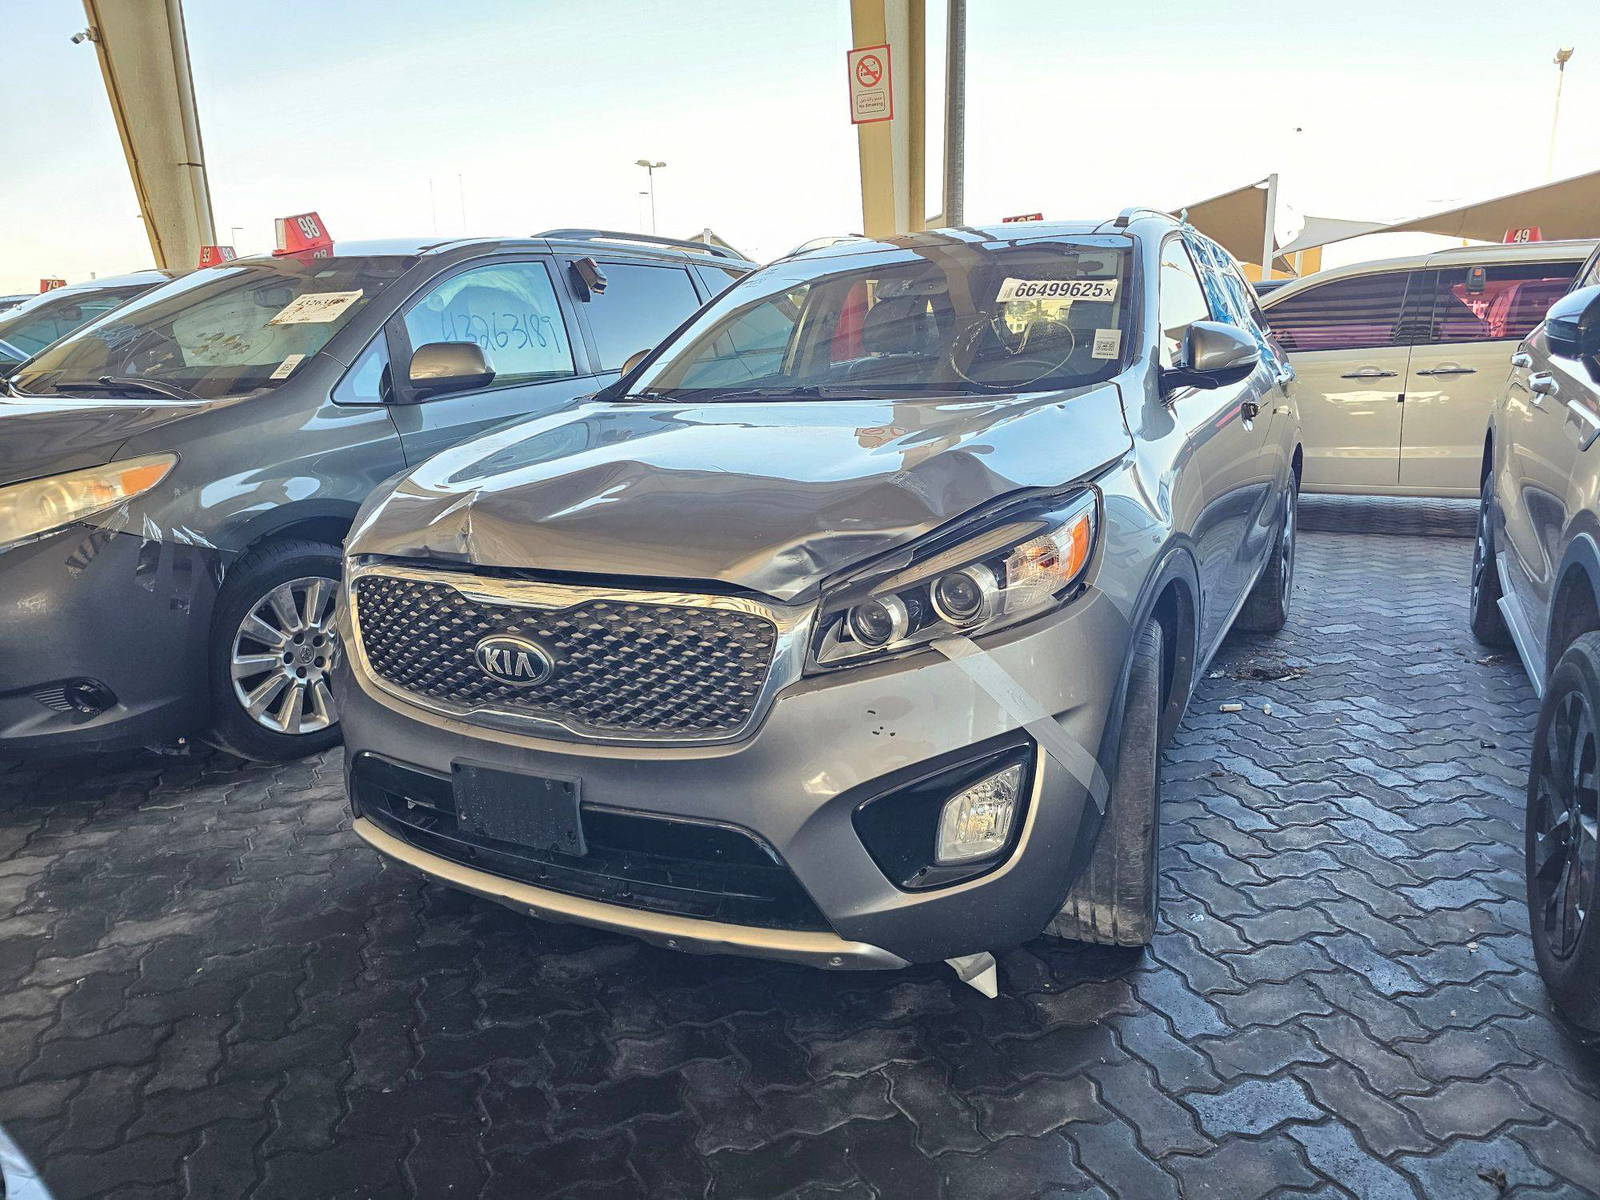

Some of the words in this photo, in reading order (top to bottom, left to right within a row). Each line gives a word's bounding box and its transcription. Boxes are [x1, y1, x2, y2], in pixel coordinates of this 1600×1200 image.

[297, 215, 321, 239] 98
[1513, 229, 1530, 243] 49
[483, 646, 536, 678] KIA
